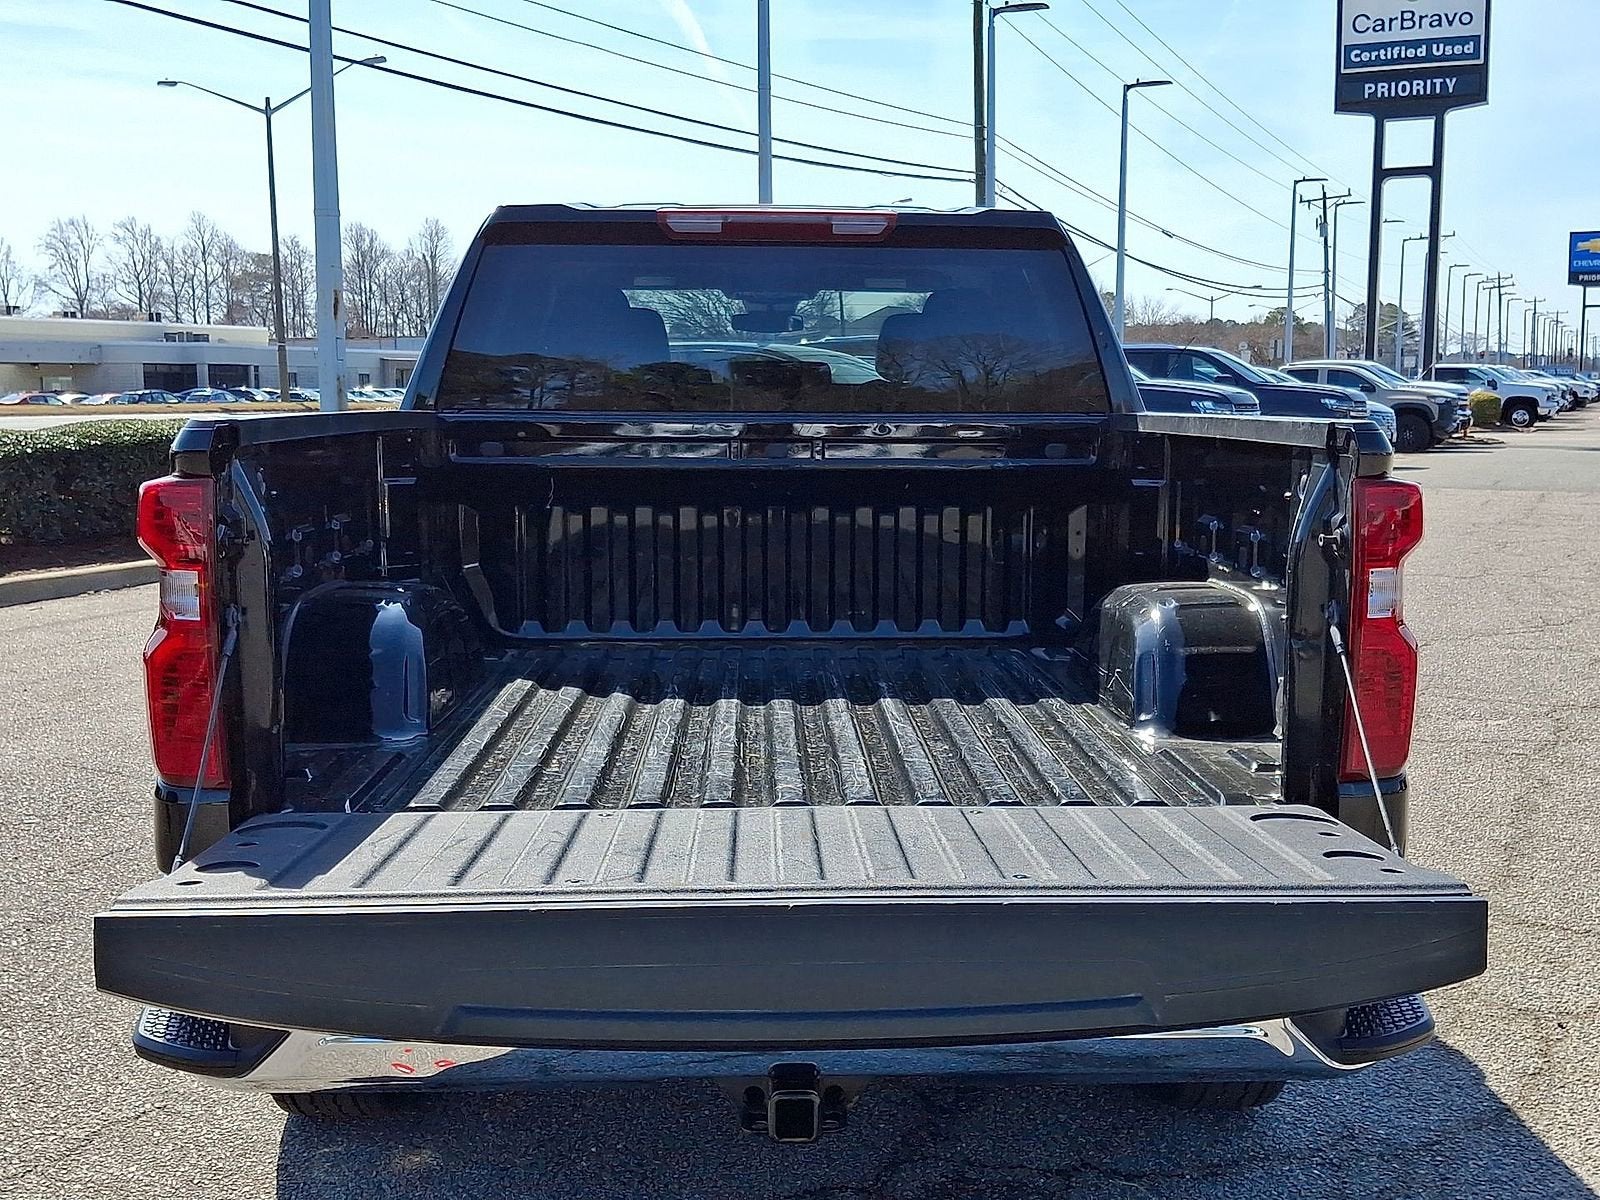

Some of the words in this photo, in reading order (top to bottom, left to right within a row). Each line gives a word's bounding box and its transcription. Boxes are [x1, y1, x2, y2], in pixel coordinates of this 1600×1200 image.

[1352, 10, 1473, 34] CarBravo
[1350, 44, 1427, 62] Certified
[1432, 41, 1474, 57] Used
[1364, 77, 1457, 99] PRIORITY
